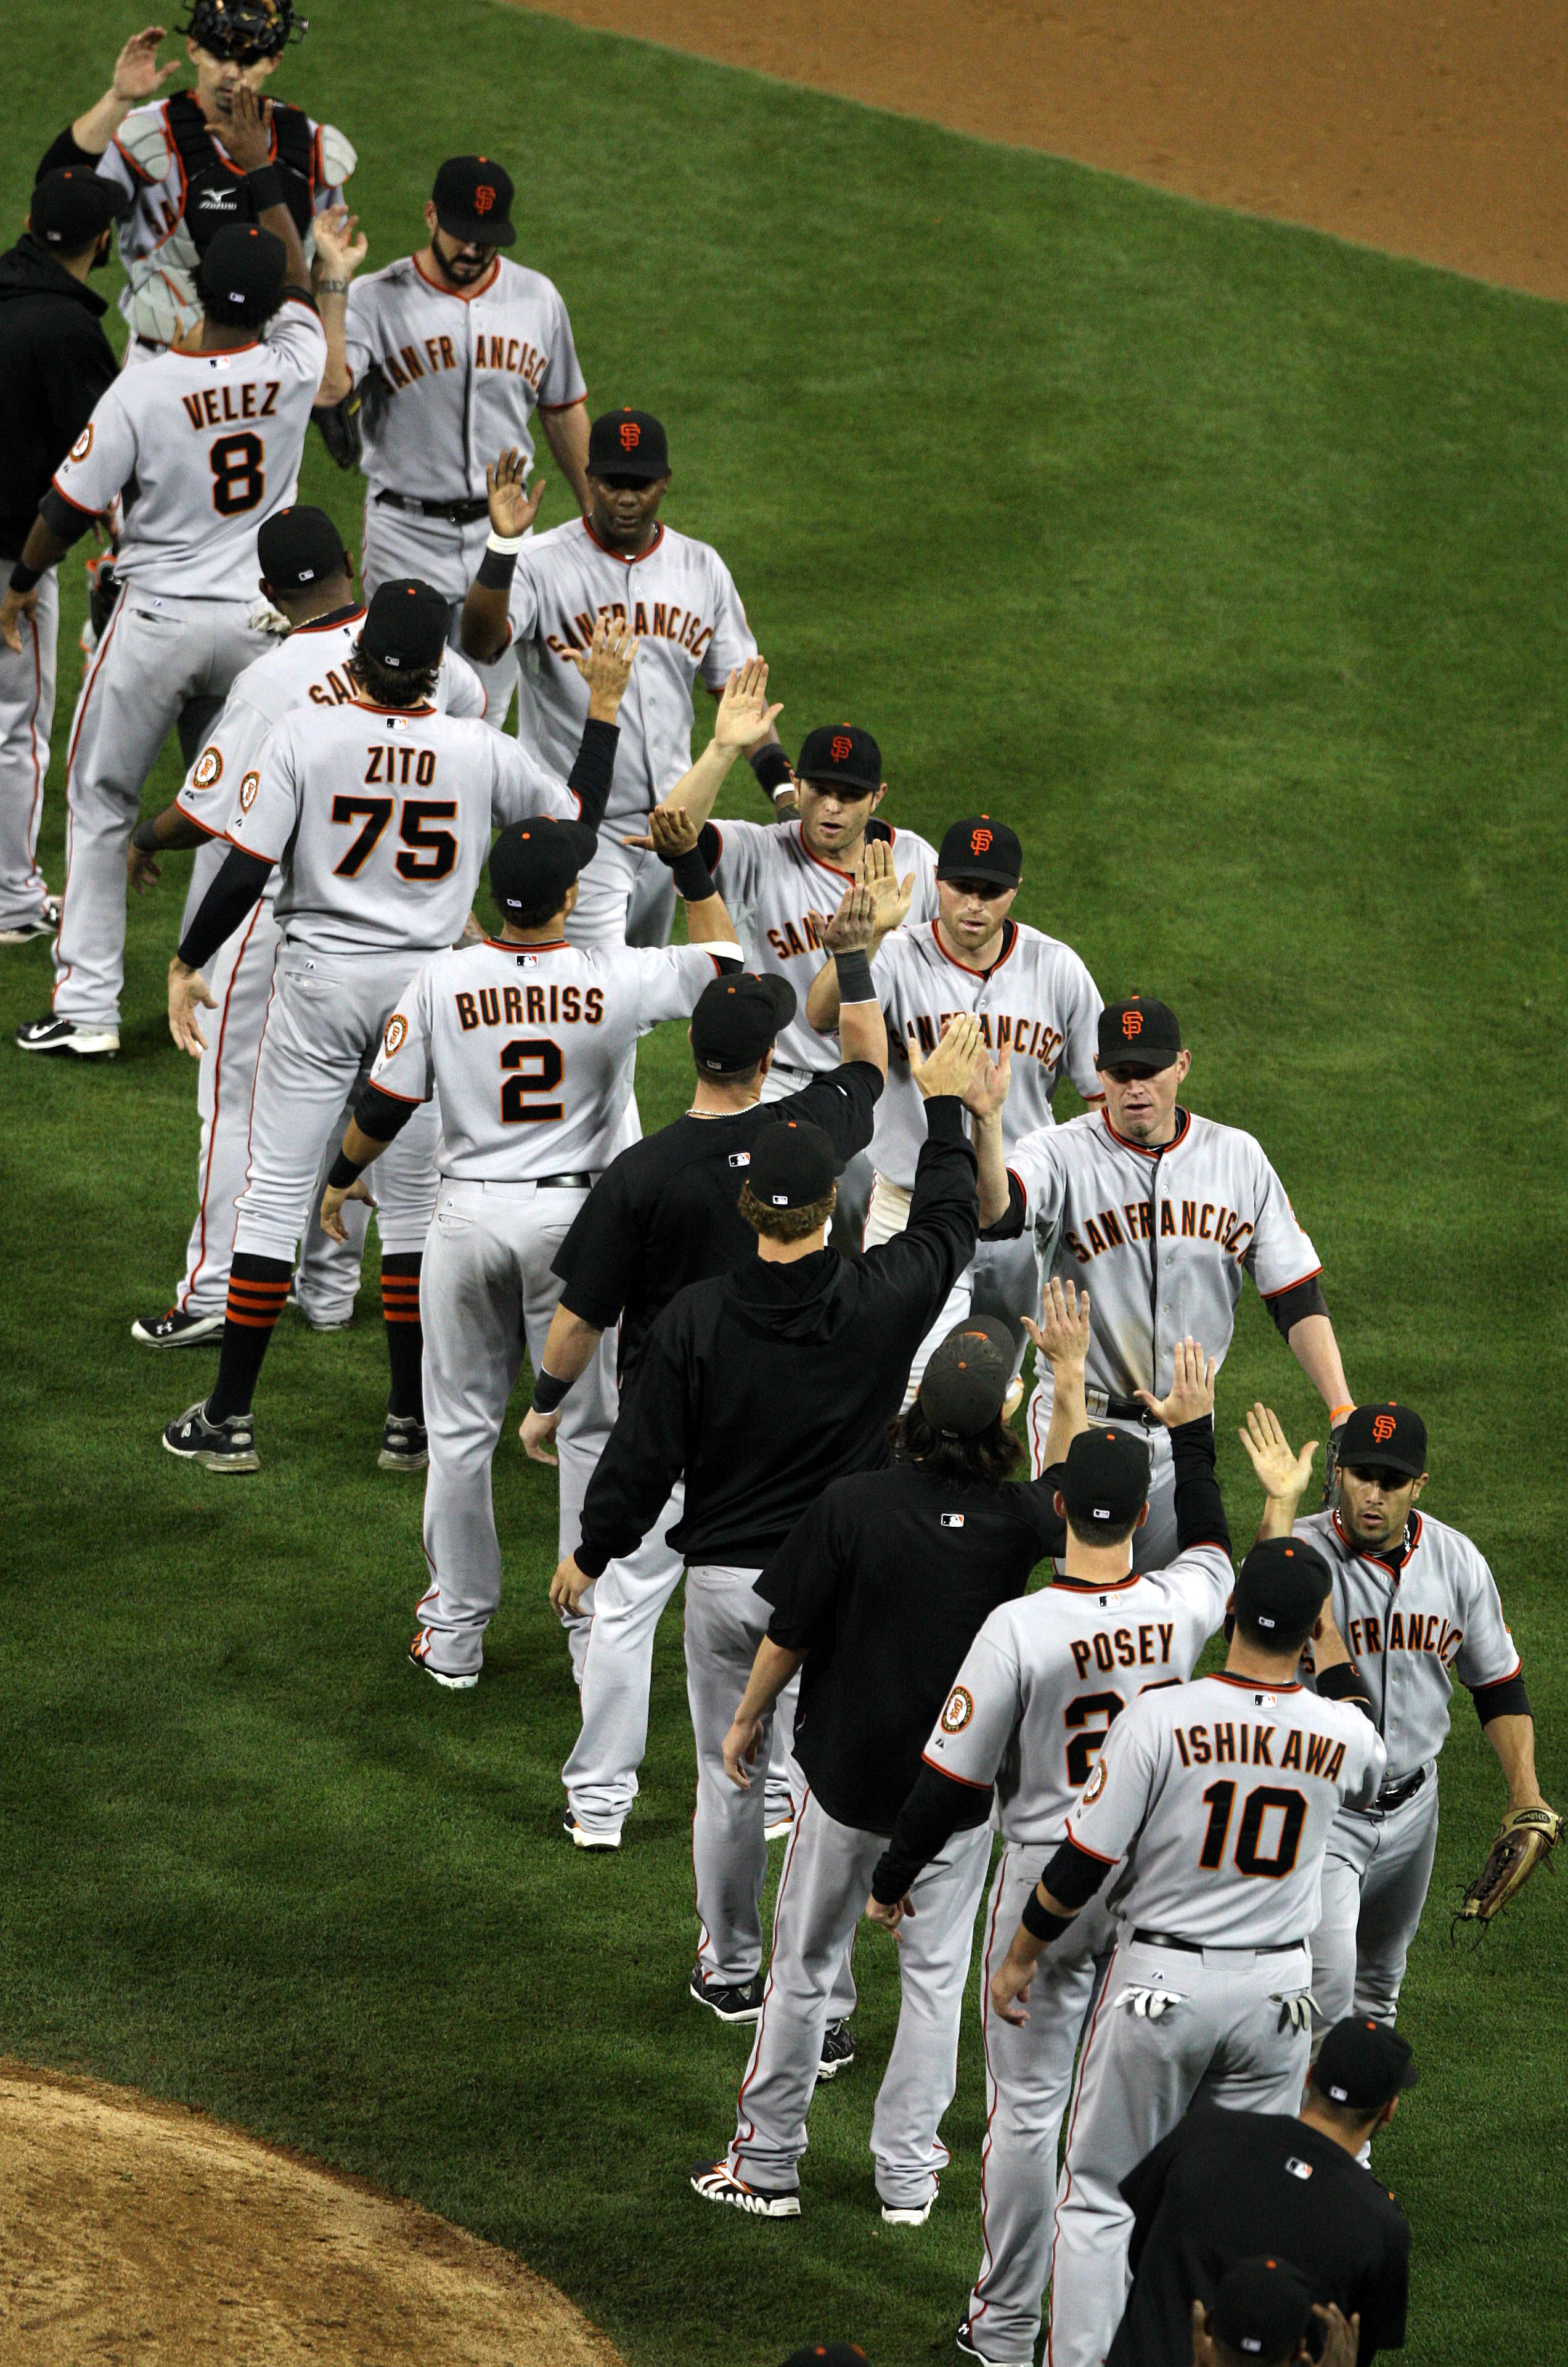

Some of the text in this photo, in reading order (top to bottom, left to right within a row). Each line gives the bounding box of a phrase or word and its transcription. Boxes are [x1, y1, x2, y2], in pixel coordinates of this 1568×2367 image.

[475, 185, 496, 216] SF
[425, 335, 547, 395] FRANCISC
[182, 381, 281, 431] VELEZ
[619, 422, 640, 452] SF
[210, 430, 265, 517] 8
[598, 602, 713, 657] FRANCISC
[365, 746, 436, 787] ZITO
[830, 735, 853, 764] SF
[331, 794, 459, 881] 75
[970, 828, 994, 857] SF
[455, 985, 605, 1032] BURRISS
[1122, 1010, 1144, 1040] SF
[500, 1039, 565, 1124] 2
[1065, 1200, 1254, 1265] SAN FRANCISC
[1372, 1415, 1397, 1444] SF
[1069, 1622, 1174, 1680] POSEY
[1350, 1613, 1463, 1669] FRANCIC
[1064, 1677, 1184, 1787] 2
[1174, 1722, 1347, 1783] ISHIKAWA
[1198, 1779, 1309, 1881] 10
